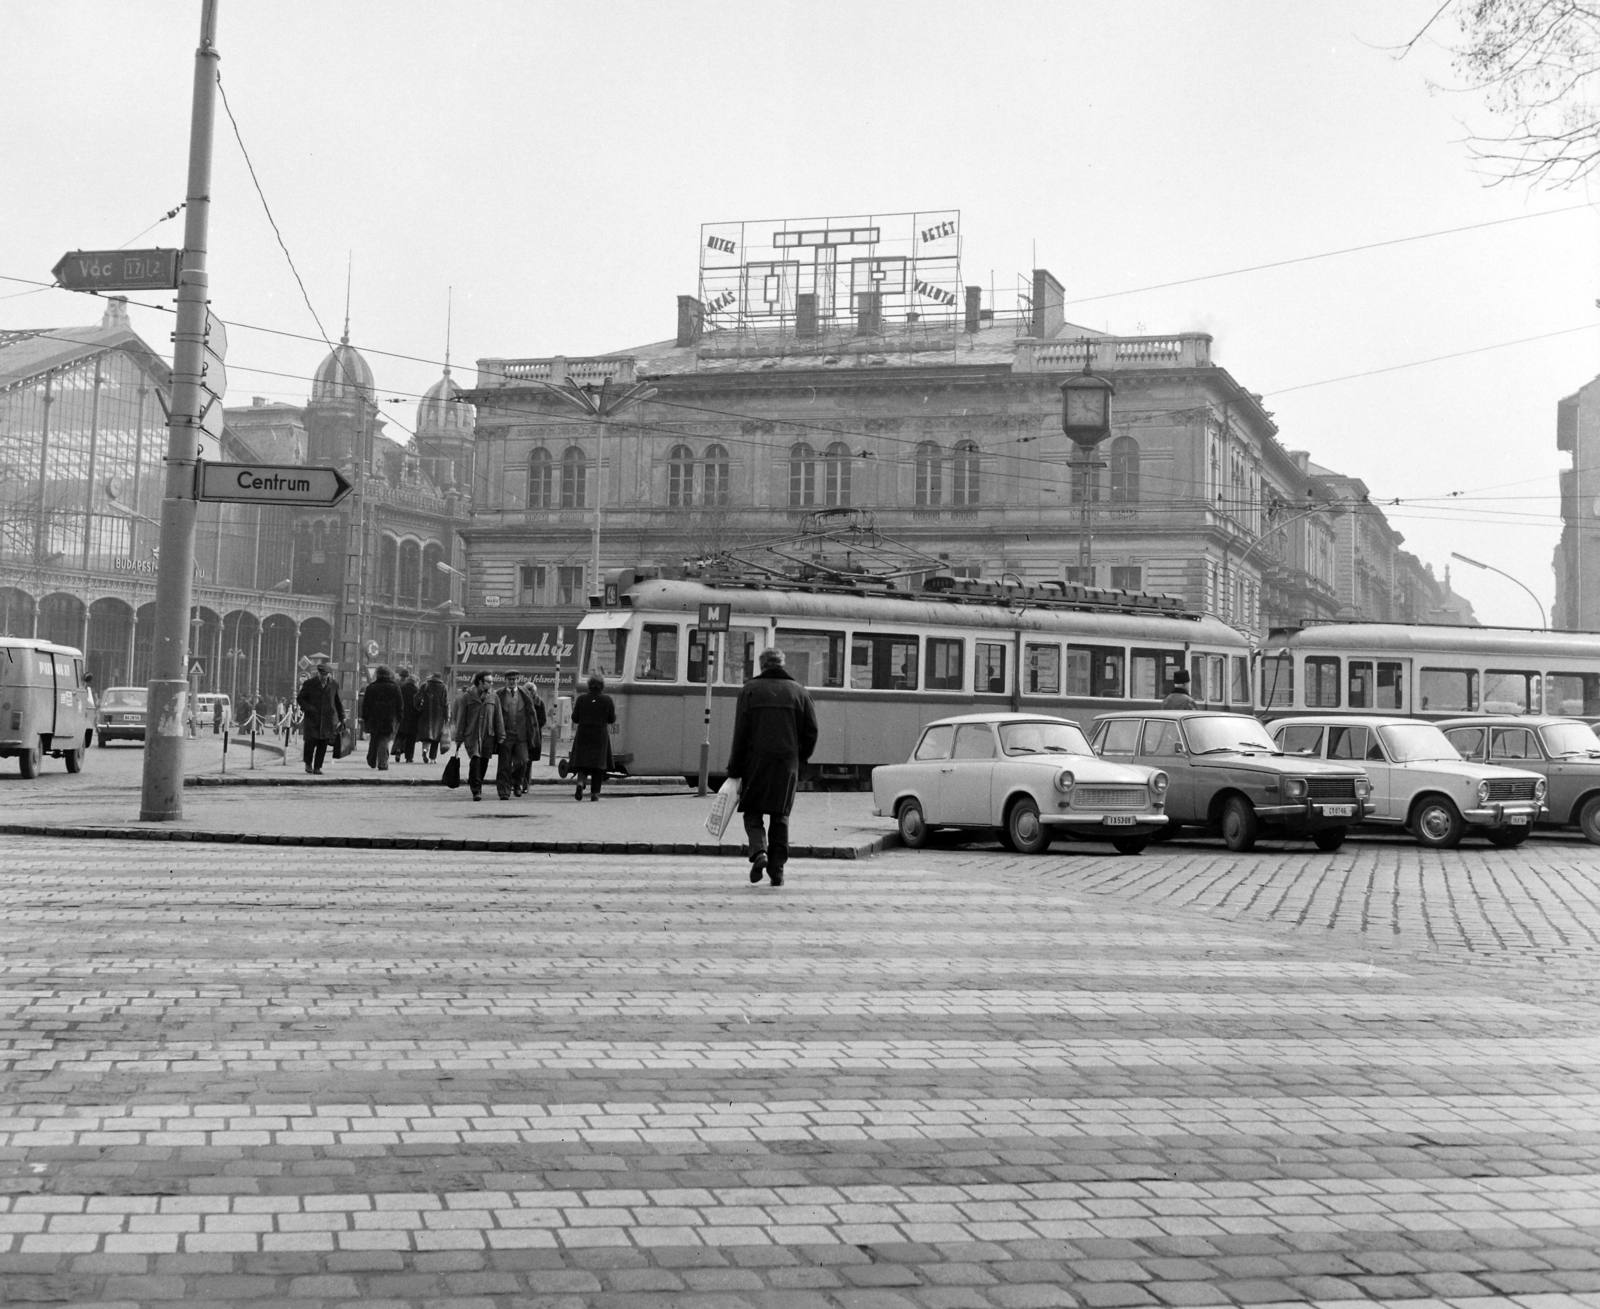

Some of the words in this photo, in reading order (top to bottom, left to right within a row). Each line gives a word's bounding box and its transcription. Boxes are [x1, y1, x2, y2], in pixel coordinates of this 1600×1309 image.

[921, 221, 955, 243] BETÉT
[79, 258, 112, 278] Vác
[127, 262, 141, 275] 17
[745, 227, 906, 318] OTP
[914, 279, 956, 307] VALUTA
[237, 471, 310, 492] Centrum
[708, 606, 720, 620] M
